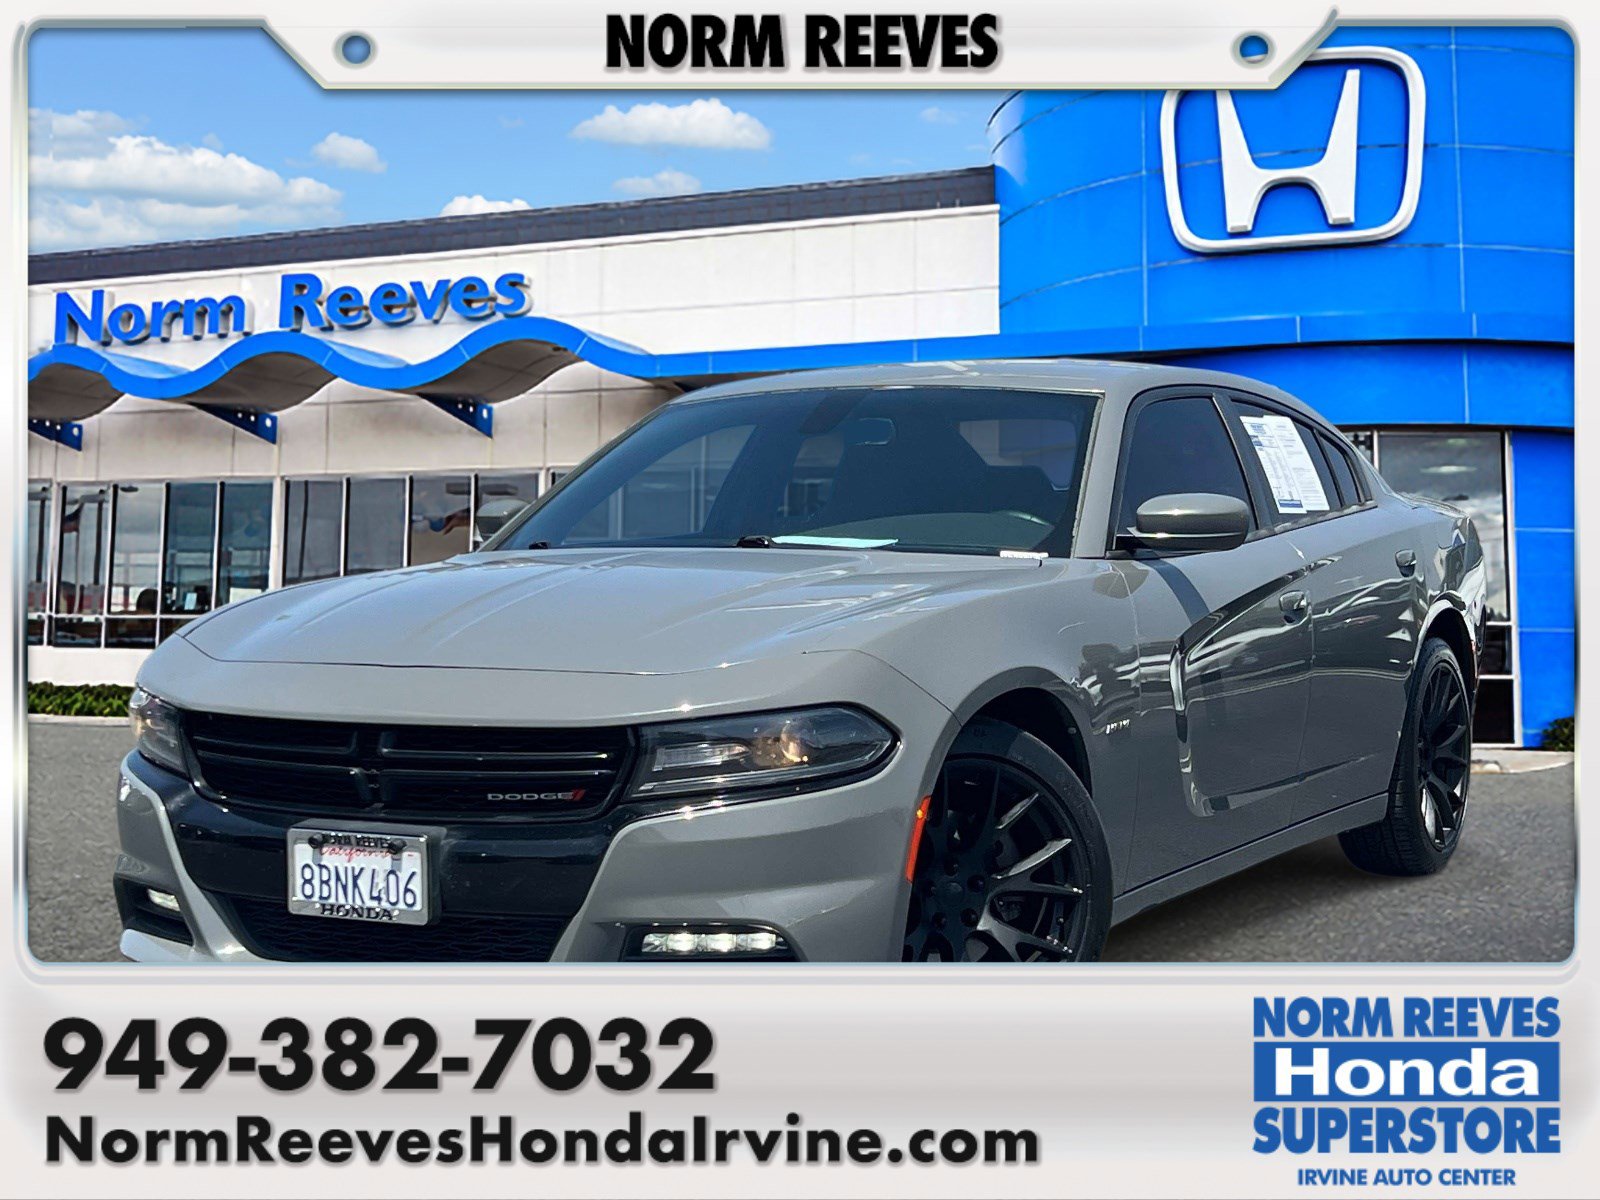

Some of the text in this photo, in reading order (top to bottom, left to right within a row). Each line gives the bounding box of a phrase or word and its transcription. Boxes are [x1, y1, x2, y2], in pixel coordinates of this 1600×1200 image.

[54, 272, 531, 346] Norm Reeves
[487, 792, 575, 801] DODGE
[301, 863, 417, 908] 8BNK406
[320, 904, 395, 921] HONDA
